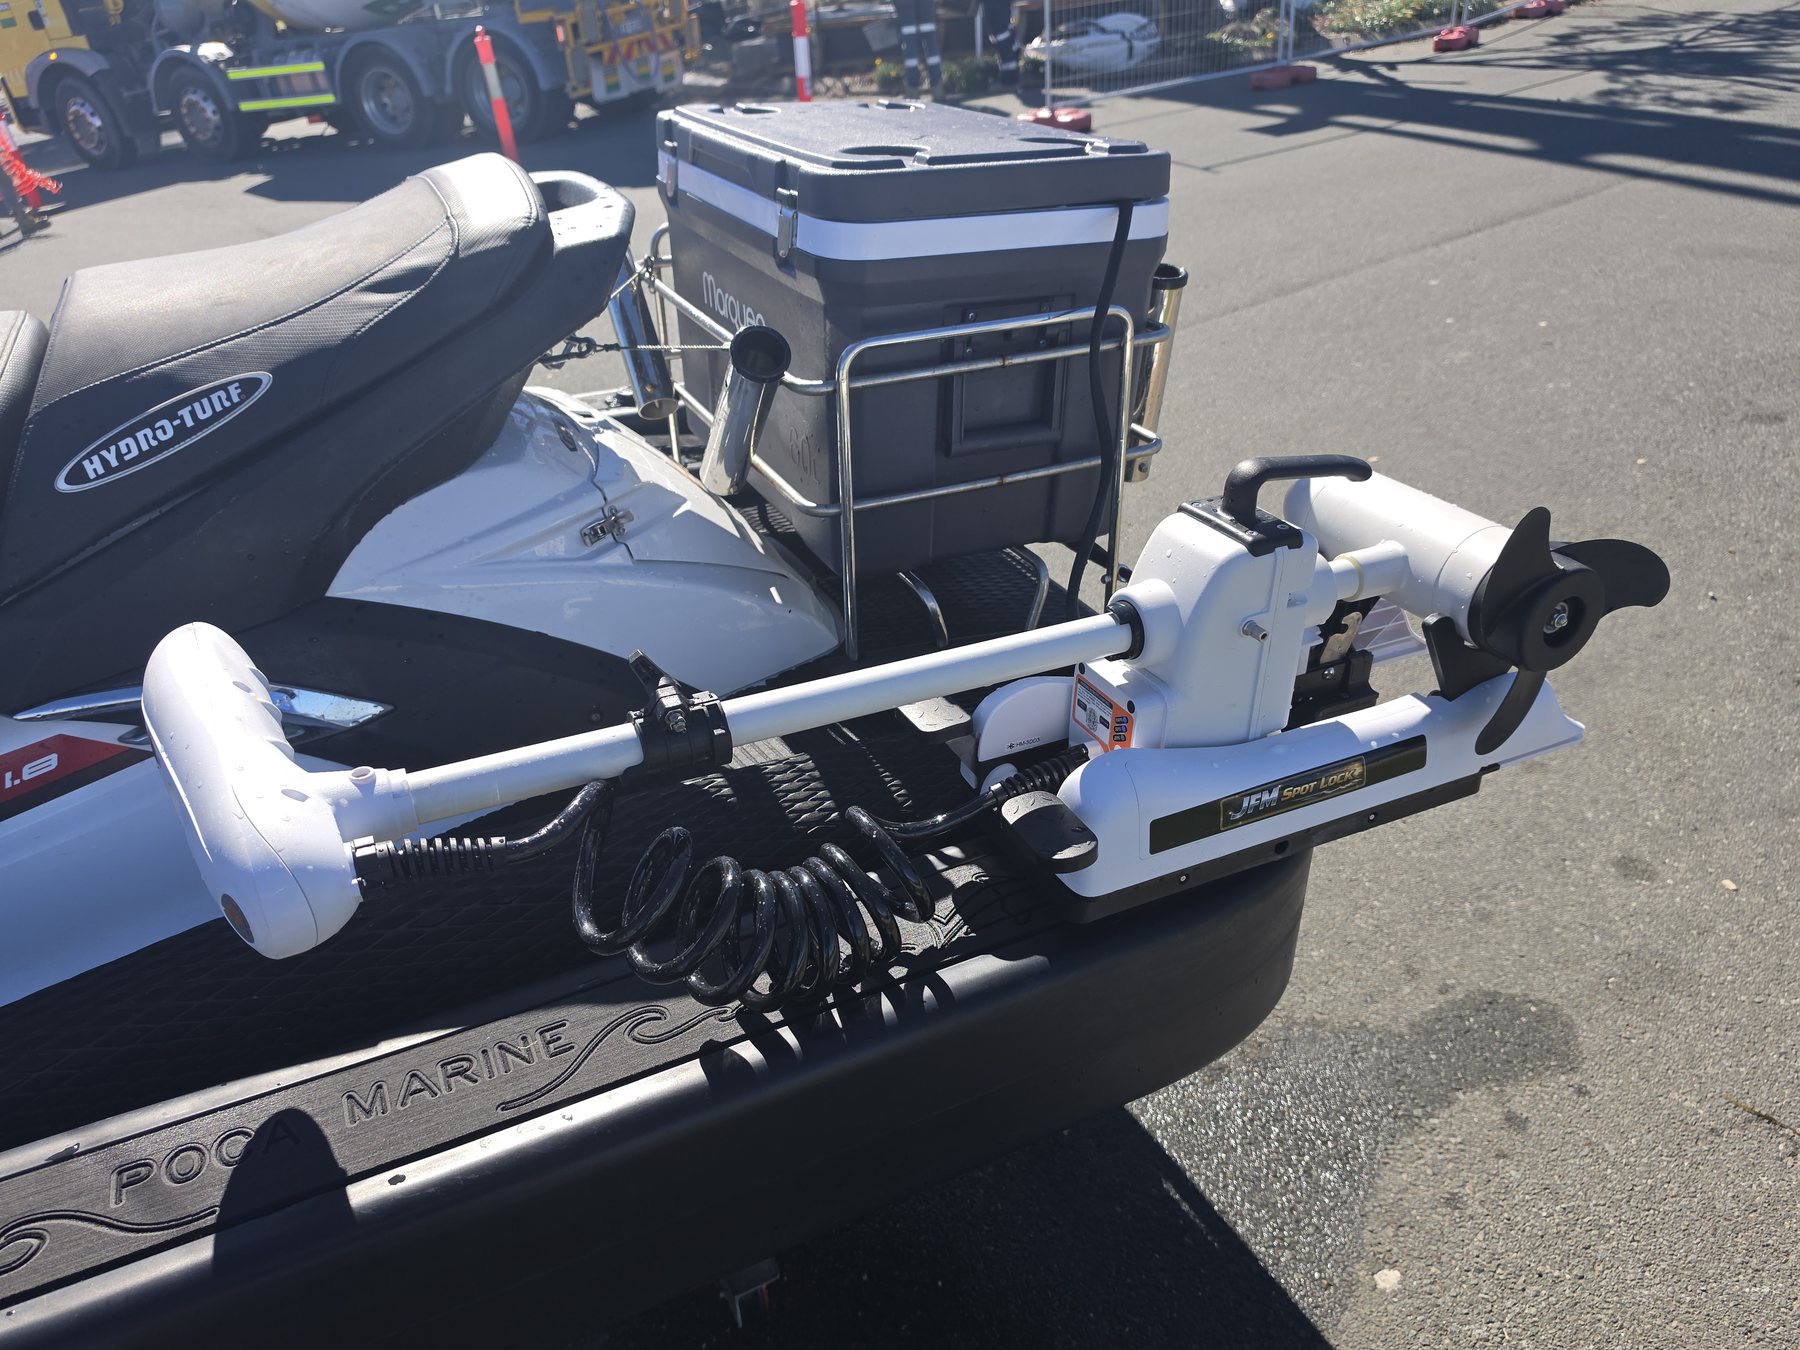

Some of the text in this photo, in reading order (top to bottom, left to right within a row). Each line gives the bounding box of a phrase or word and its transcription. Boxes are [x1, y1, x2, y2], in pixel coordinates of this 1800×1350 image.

[81, 382, 243, 480] HYDRO-TURF
[4, 752, 59, 789] 1.8
[1230, 785, 1281, 820] JFM
[109, 1019, 577, 1207] POCA MARINE
